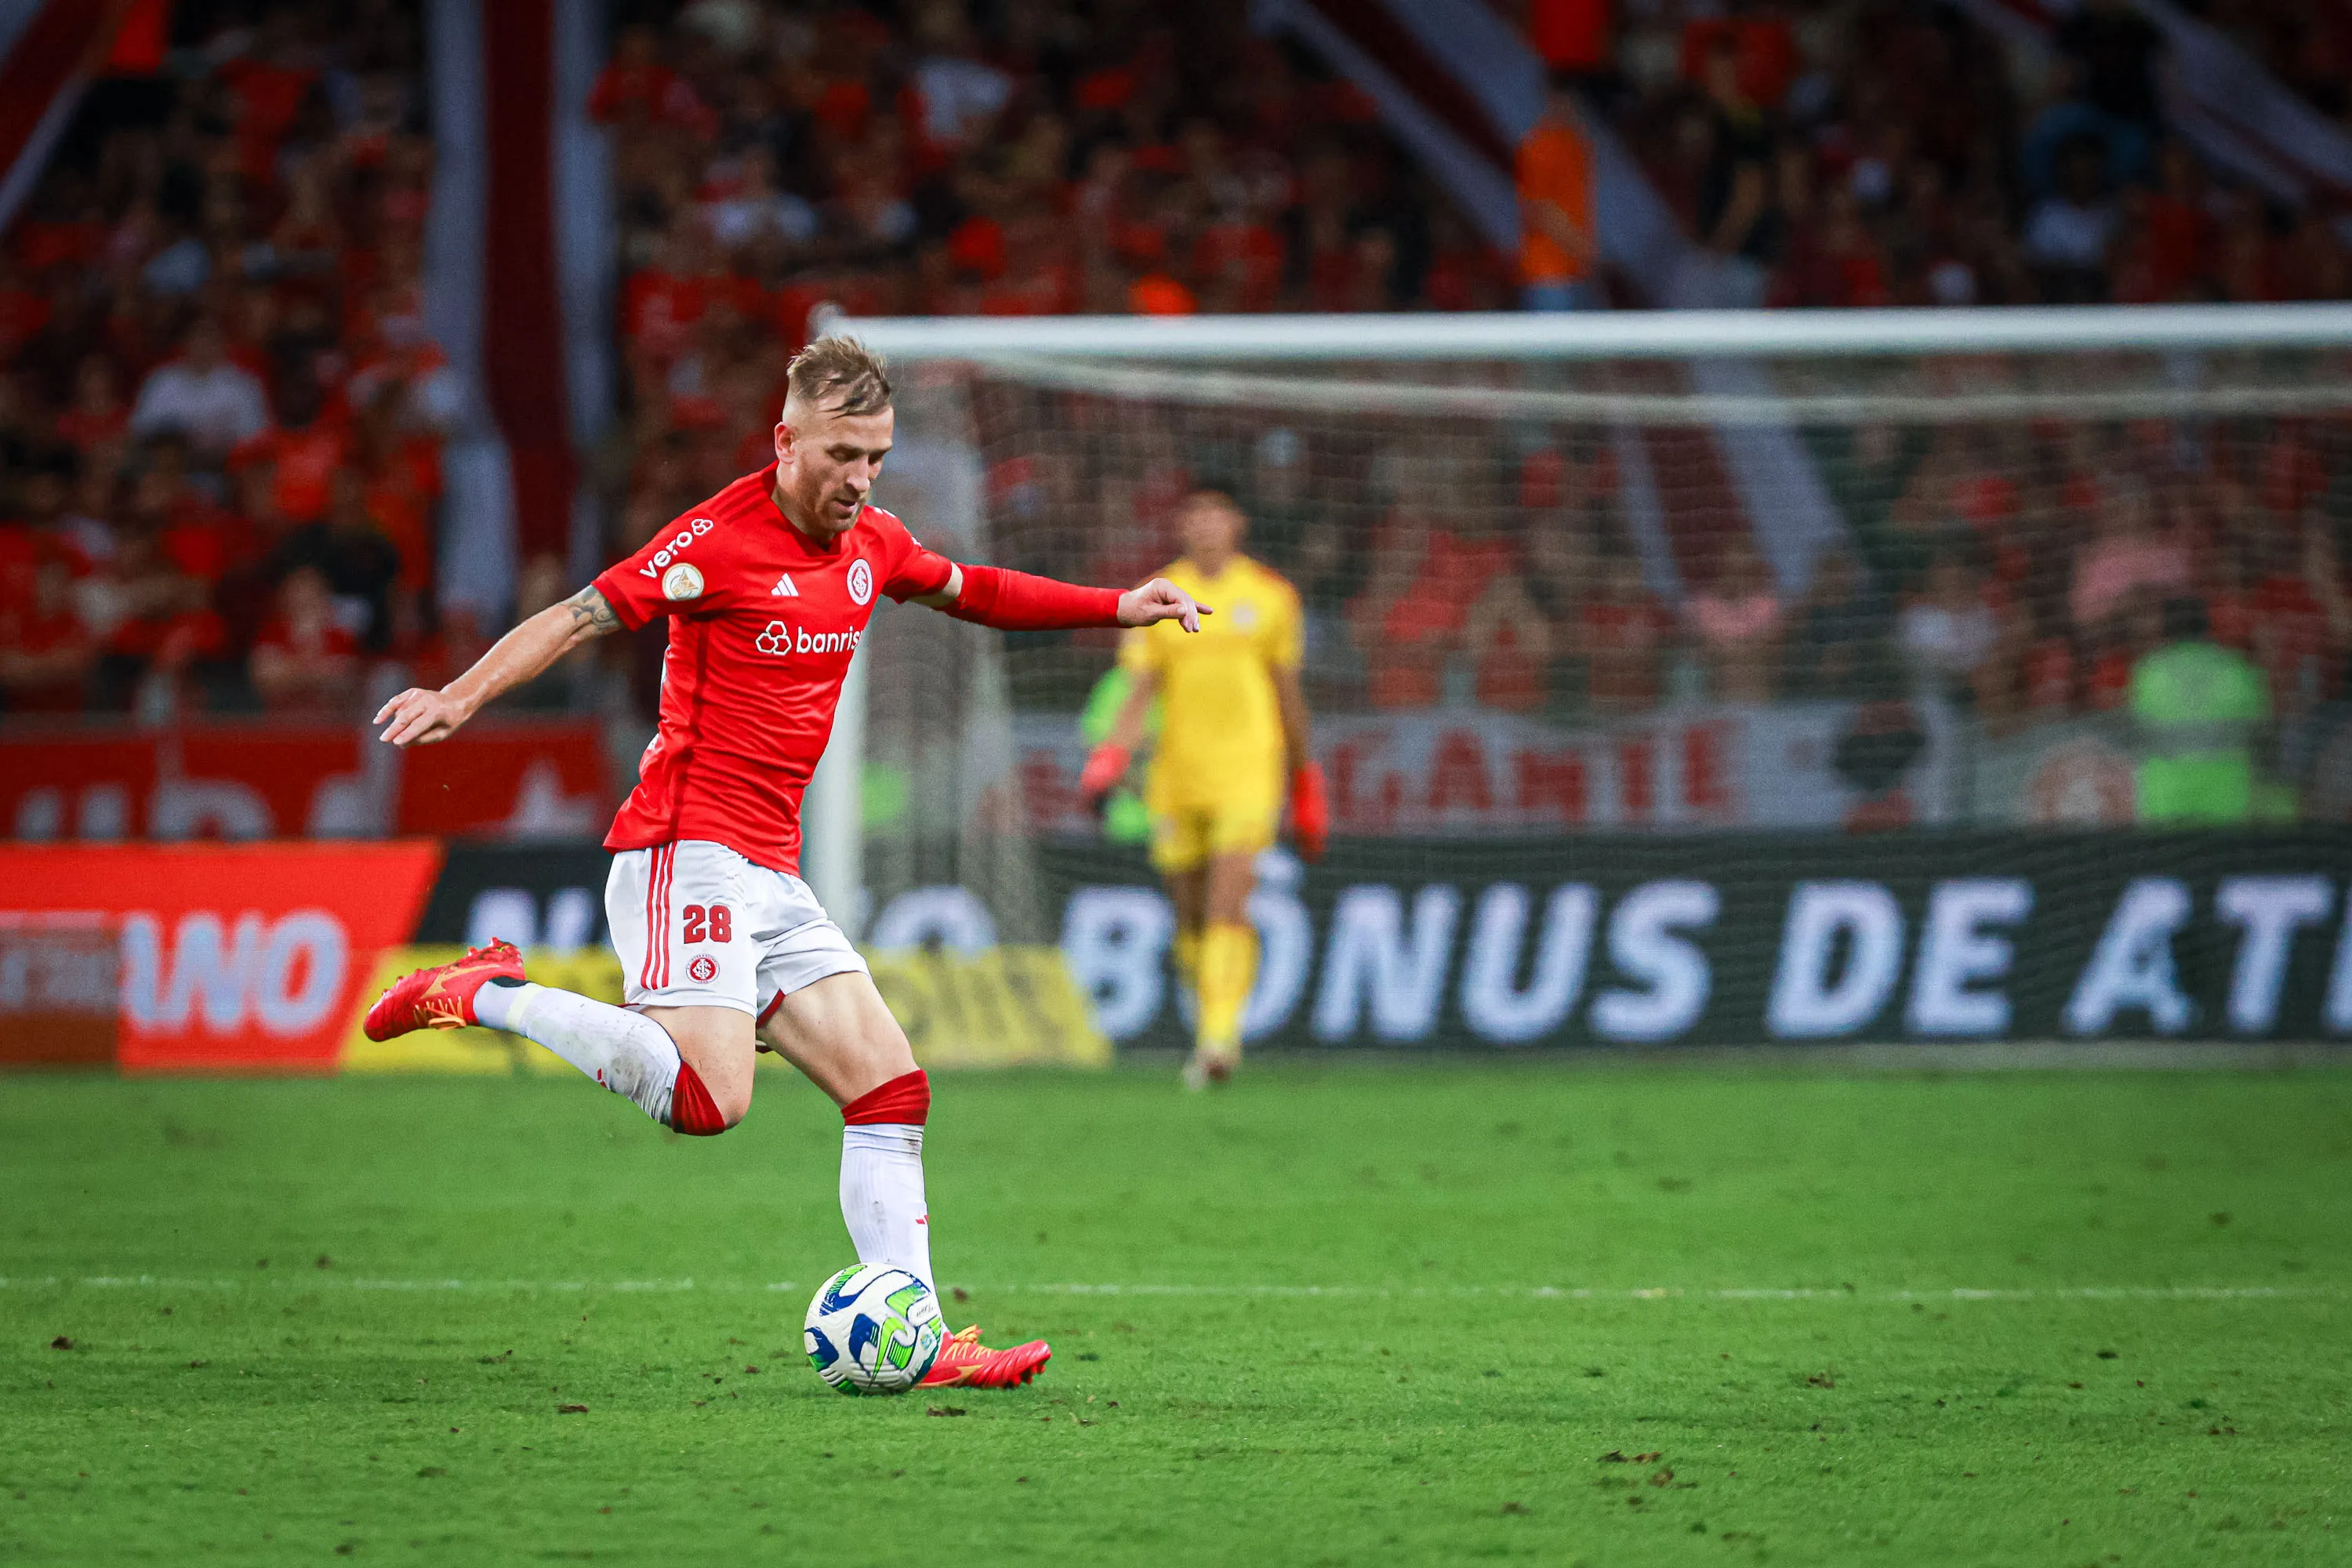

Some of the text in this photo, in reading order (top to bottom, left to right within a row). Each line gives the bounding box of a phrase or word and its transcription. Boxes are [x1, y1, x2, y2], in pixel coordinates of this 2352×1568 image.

[639, 531, 693, 579] vero
[796, 626, 863, 654] banris
[683, 904, 732, 944] 28
[1766, 876, 2034, 1038] DE
